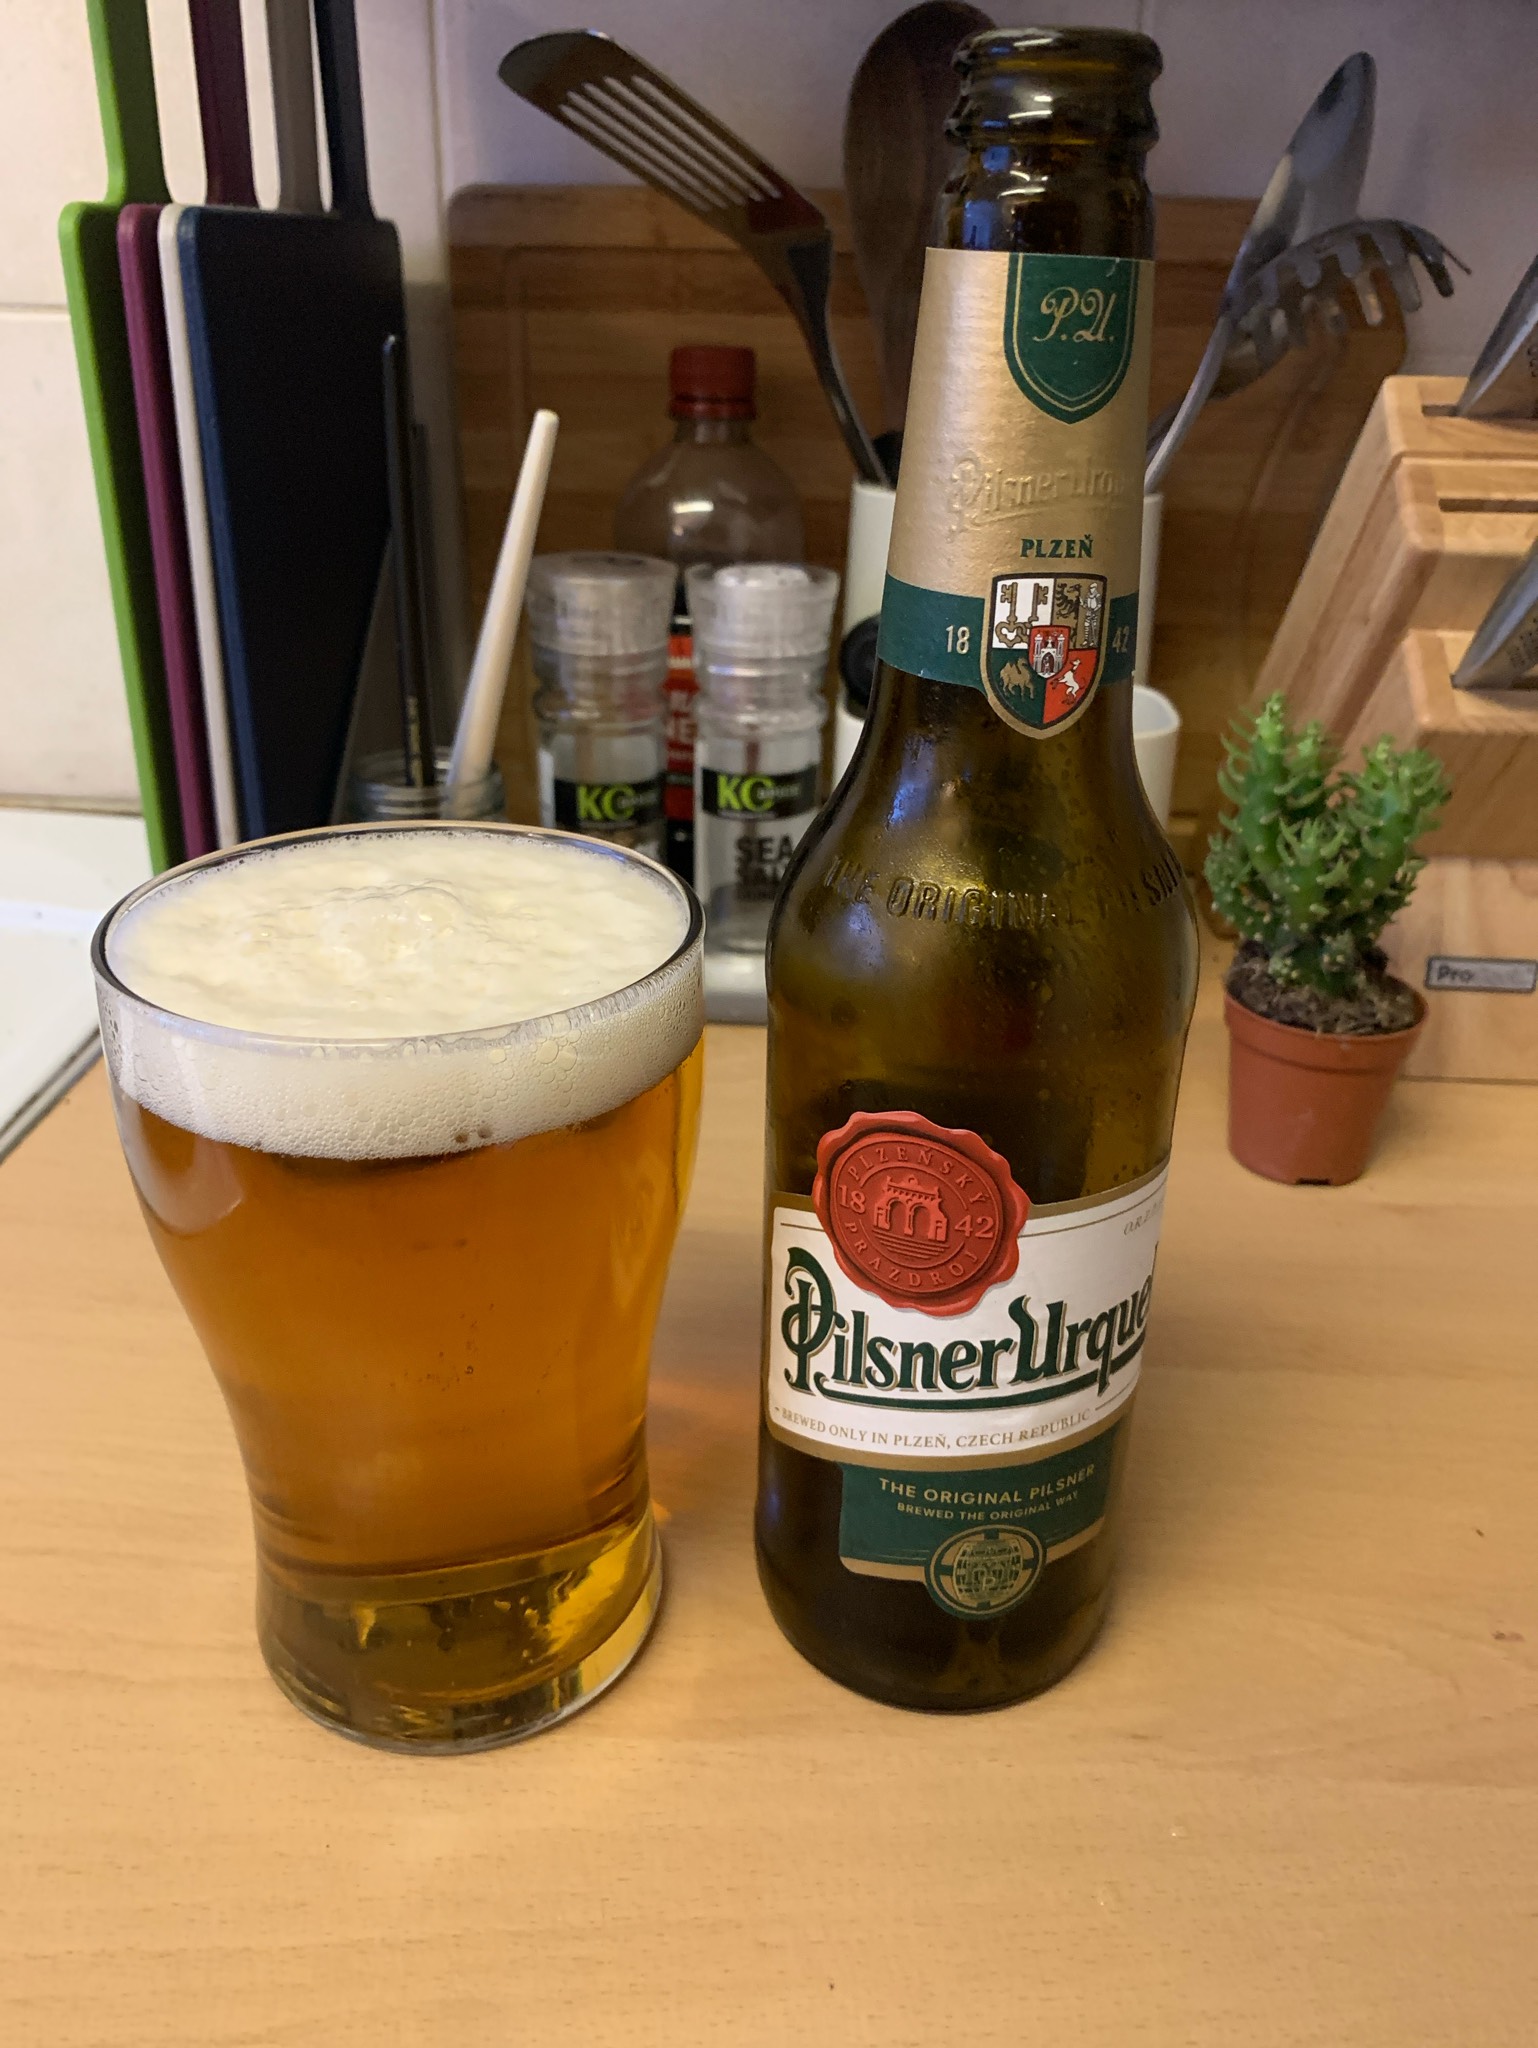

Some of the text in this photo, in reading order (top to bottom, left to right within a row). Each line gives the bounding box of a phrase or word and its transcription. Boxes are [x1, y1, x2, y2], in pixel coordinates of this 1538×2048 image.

[1020, 534, 1094, 559] PLZEŇ
[946, 624, 971, 655] 18
[1112, 626, 1131, 653] 42
[838, 1184, 867, 1214] 18
[954, 1214, 995, 1239] 42
[845, 1221, 978, 1288] PRAZDROJ
[780, 1246, 1153, 1397] Pilsner Urque
[782, 1407, 1091, 1450] BREWED ONLY IN PLZEŇ, CZECH REPUBLIC
[879, 1463, 1096, 1505] THE ORIGINAL PILSNER
[897, 1491, 1079, 1521] BREWED THE ORIGINAL WAY
